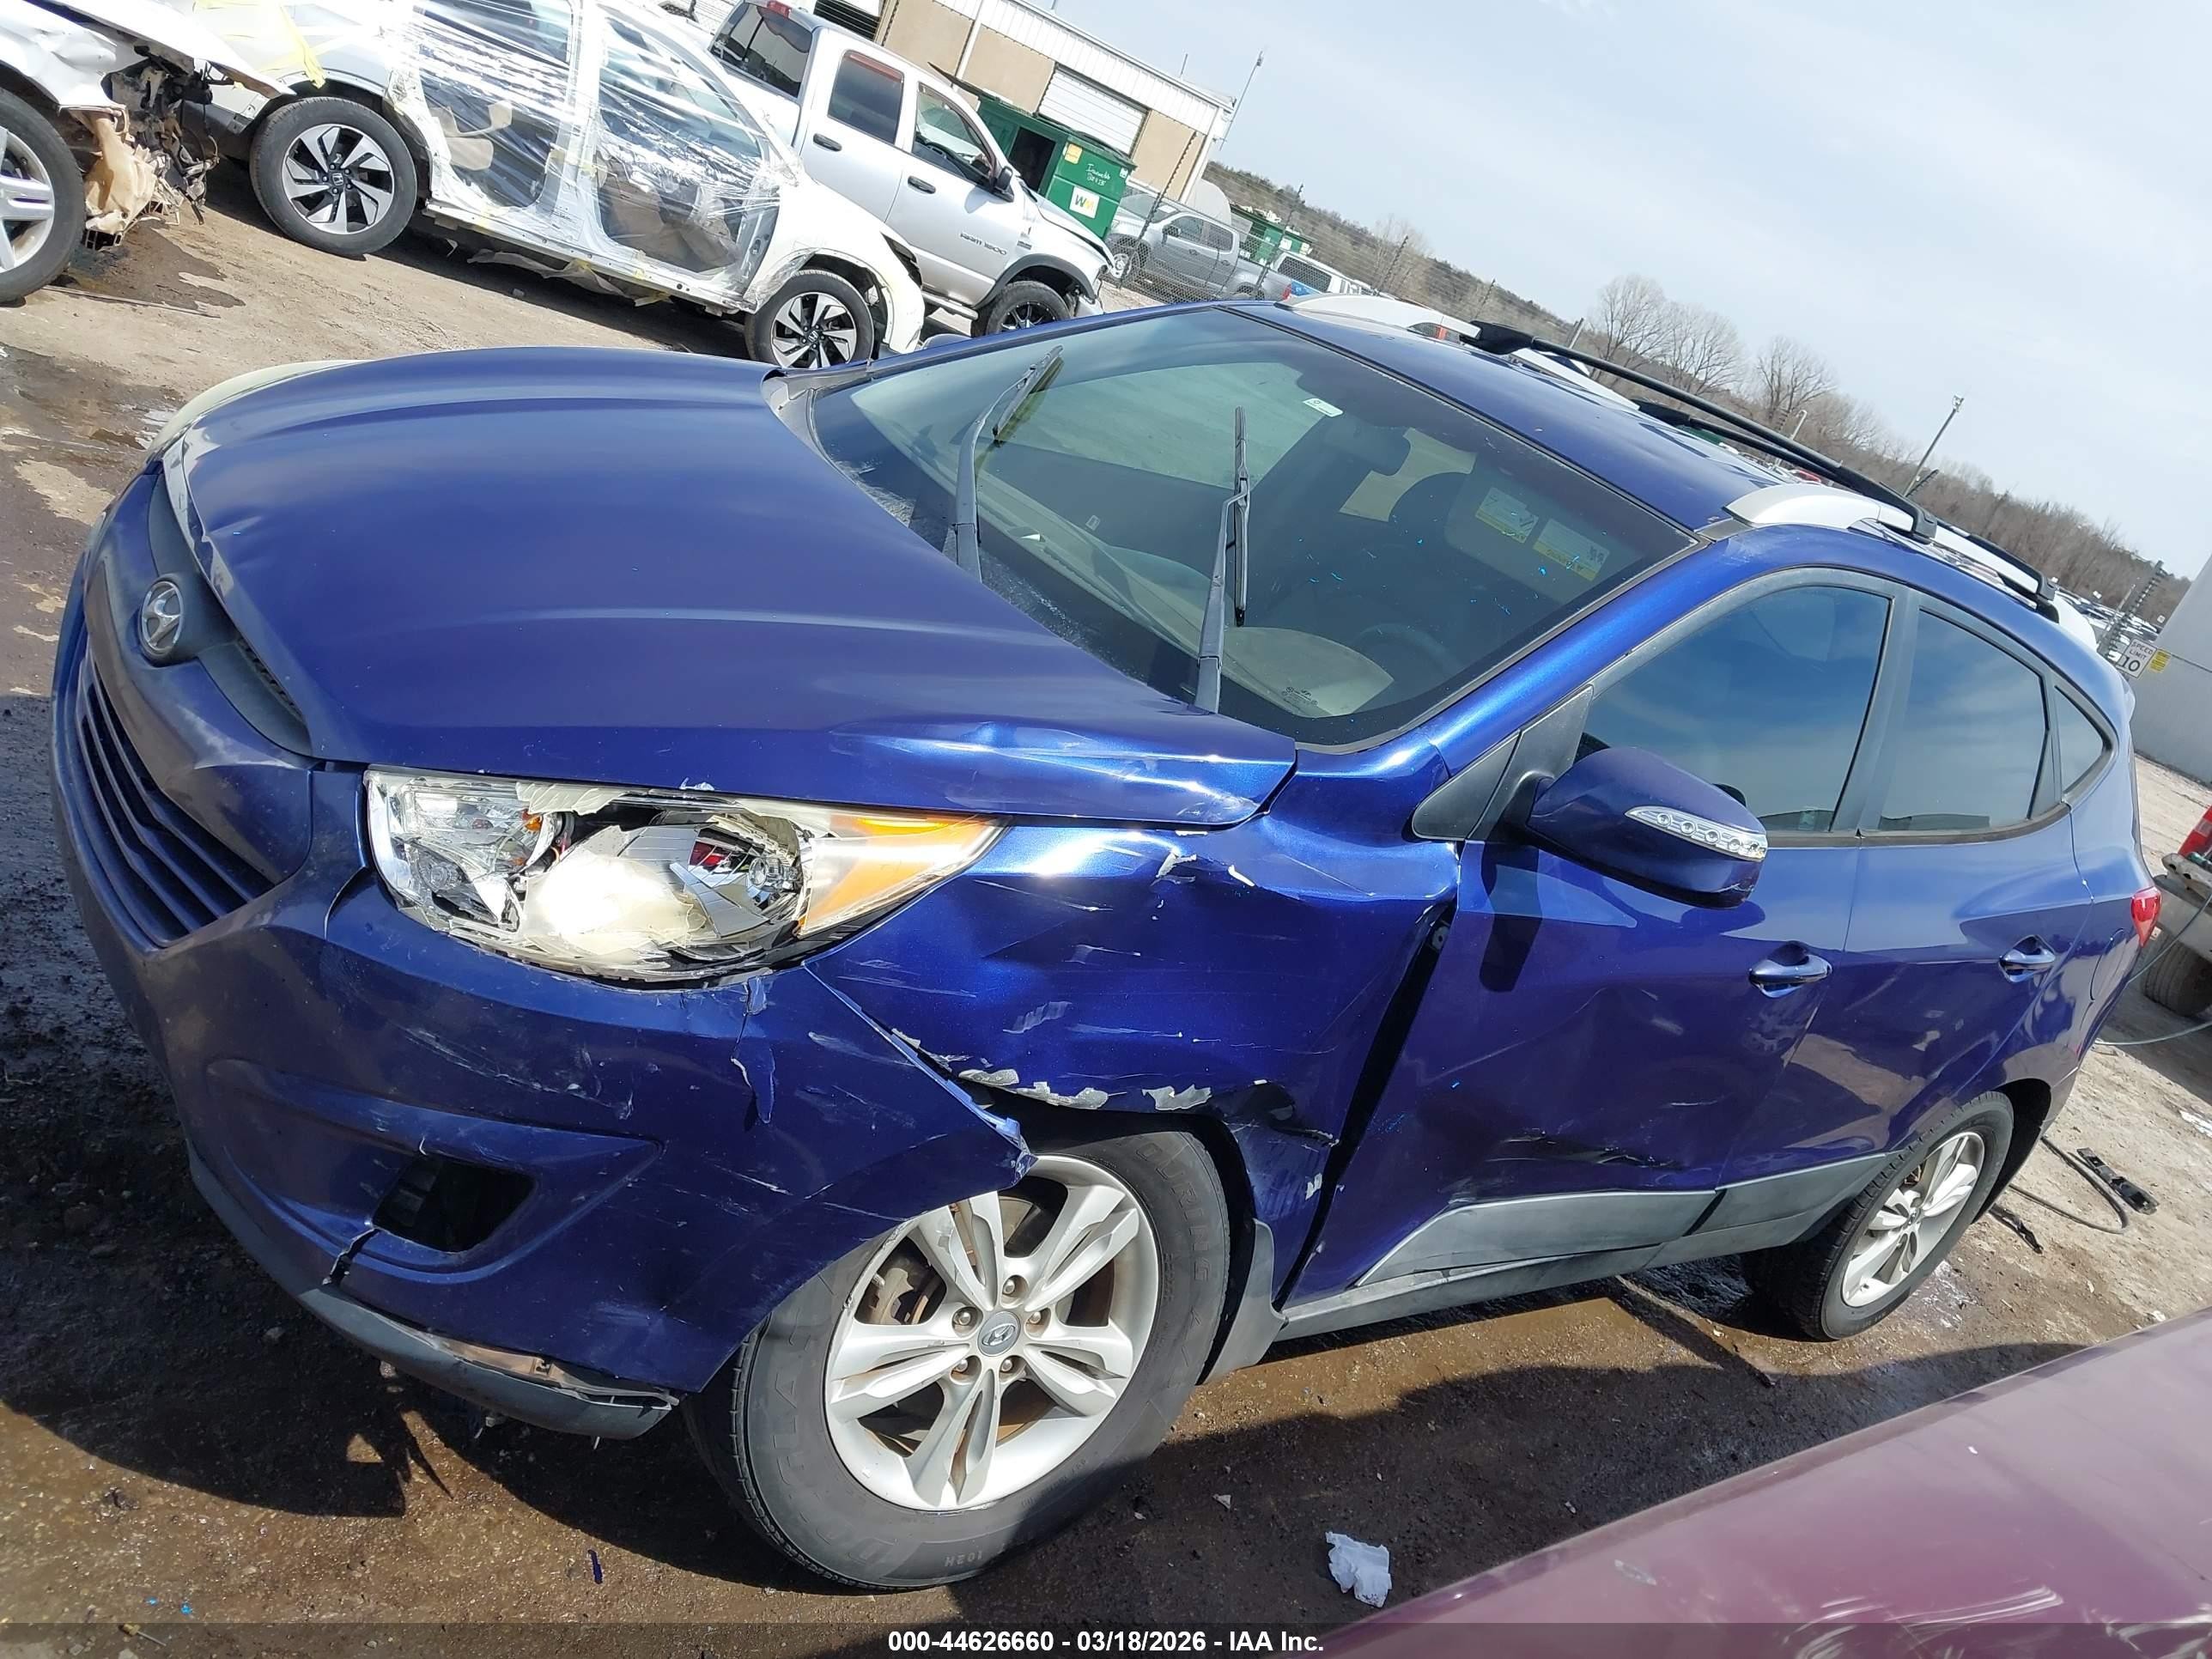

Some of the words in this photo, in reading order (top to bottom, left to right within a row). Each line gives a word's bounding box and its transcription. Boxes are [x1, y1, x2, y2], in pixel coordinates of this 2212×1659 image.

[2130, 641, 2154, 655] SPEED
[2130, 649, 2147, 660] LIMIT
[2120, 655, 2141, 672] 10
[945, 1551, 982, 1567] 102H
